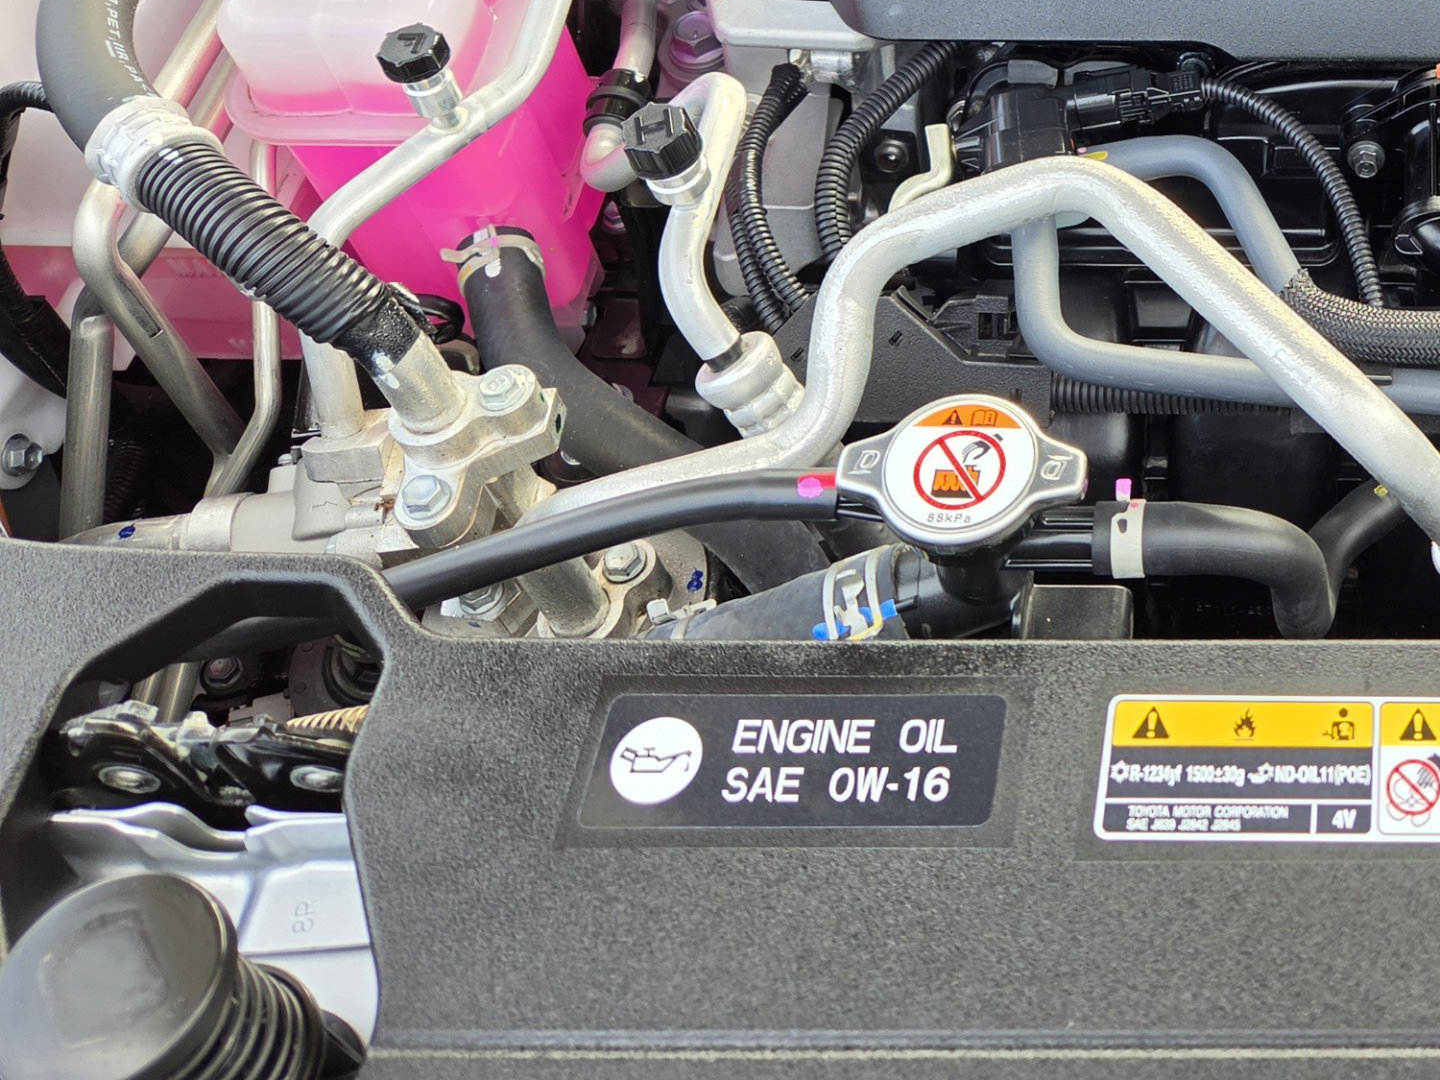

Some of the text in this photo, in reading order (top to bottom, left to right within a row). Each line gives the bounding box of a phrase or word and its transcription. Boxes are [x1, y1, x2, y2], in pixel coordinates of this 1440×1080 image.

[634, 107, 674, 146] H
[927, 512, 972, 523] 88kPa
[731, 719, 958, 754] ENGINE OIL
[721, 767, 951, 803] SAE 0W-16
[1127, 804, 1290, 819] TOYOTA MOTOR CORPORATION
[1331, 808, 1357, 829] 4V
